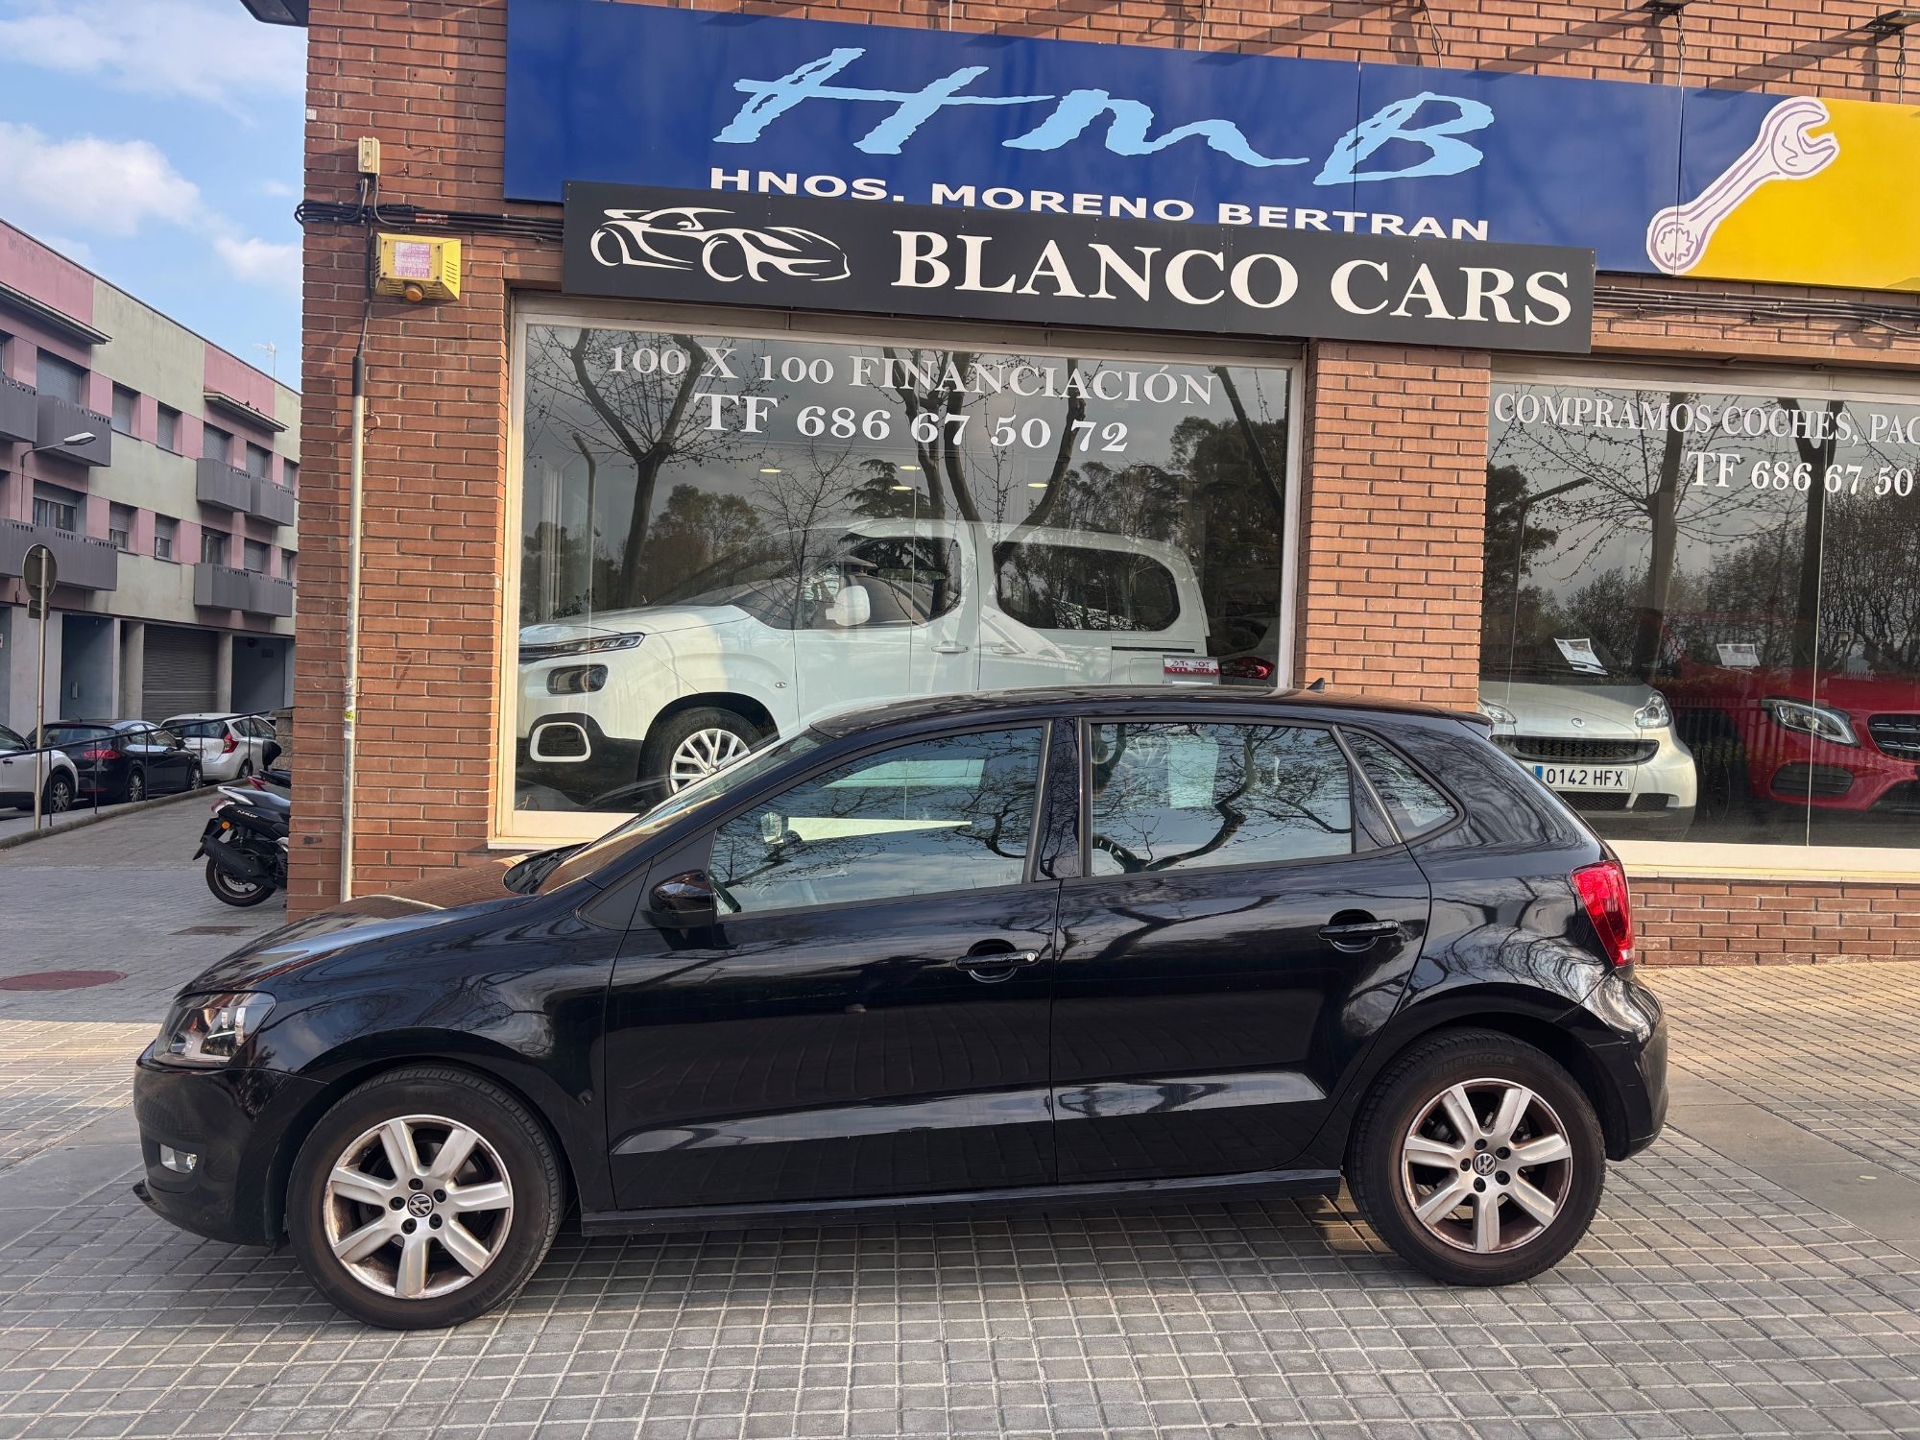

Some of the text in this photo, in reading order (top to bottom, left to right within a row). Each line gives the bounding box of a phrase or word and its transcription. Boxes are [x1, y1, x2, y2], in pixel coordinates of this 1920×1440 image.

[710, 167, 1489, 241] HNOS. MORENO BERTRAN
[890, 229, 1572, 326] BLANCO CARS
[609, 346, 1217, 405] 100 X 100 FINANCIACIÓN
[693, 392, 1129, 452] TF 686 67 50 72
[1493, 392, 1711, 433] COMPRAMOS
[1721, 405, 1859, 447] COCHES,
[1687, 451, 1914, 497] TF 686 67 50
[1546, 768, 1625, 788] 0142 HFX
